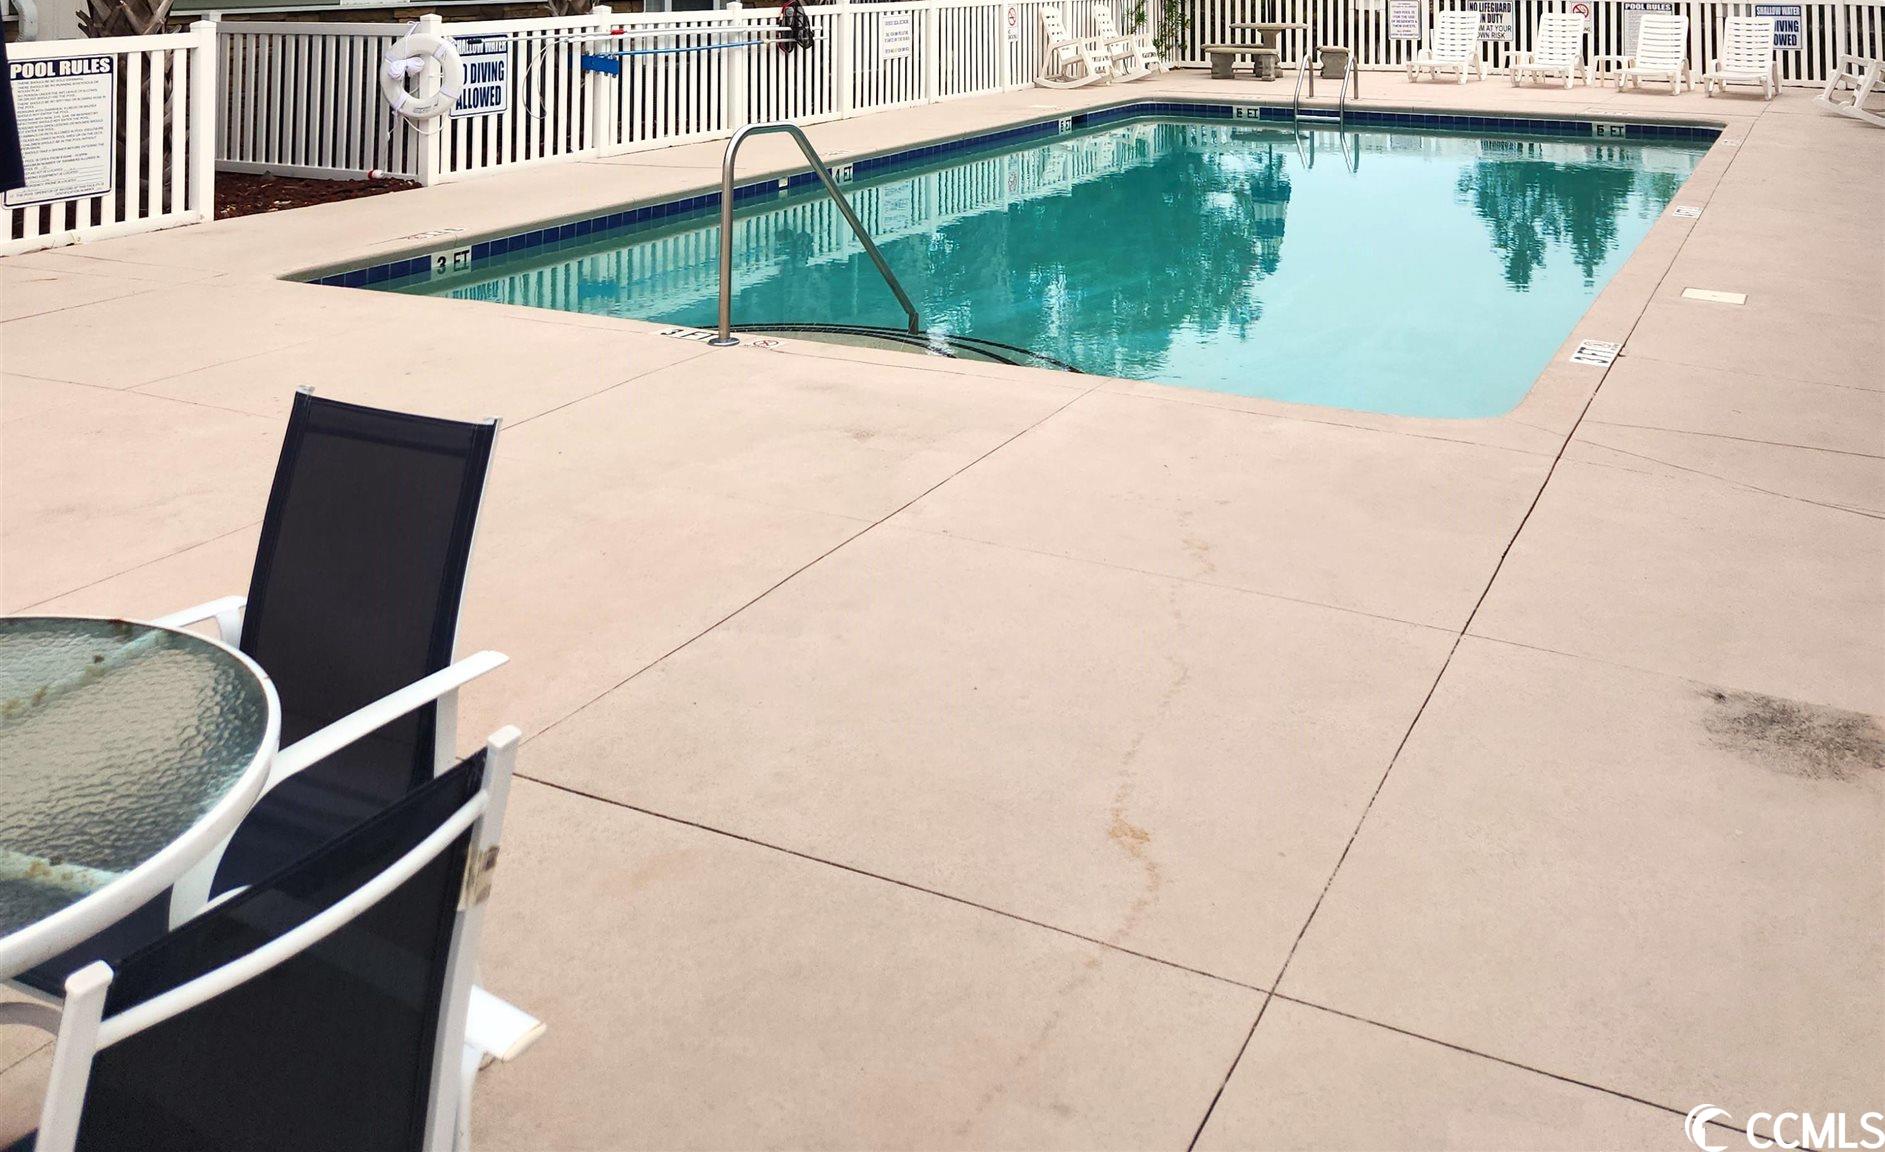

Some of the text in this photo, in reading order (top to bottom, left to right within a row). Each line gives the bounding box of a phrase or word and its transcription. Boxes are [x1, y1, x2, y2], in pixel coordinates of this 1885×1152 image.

[1470, 2, 1511, 12] NO LIFEGUARD
[1646, 3, 1671, 11] RULES
[1487, 13, 1503, 23] DUTY
[484, 41, 507, 53] WATER
[10, 58, 111, 79] POOL RULES
[470, 60, 505, 84] DIVING
[456, 86, 501, 110] ALLOWED
[1610, 126, 1624, 137] FT
[437, 249, 470, 274] 3 FT
